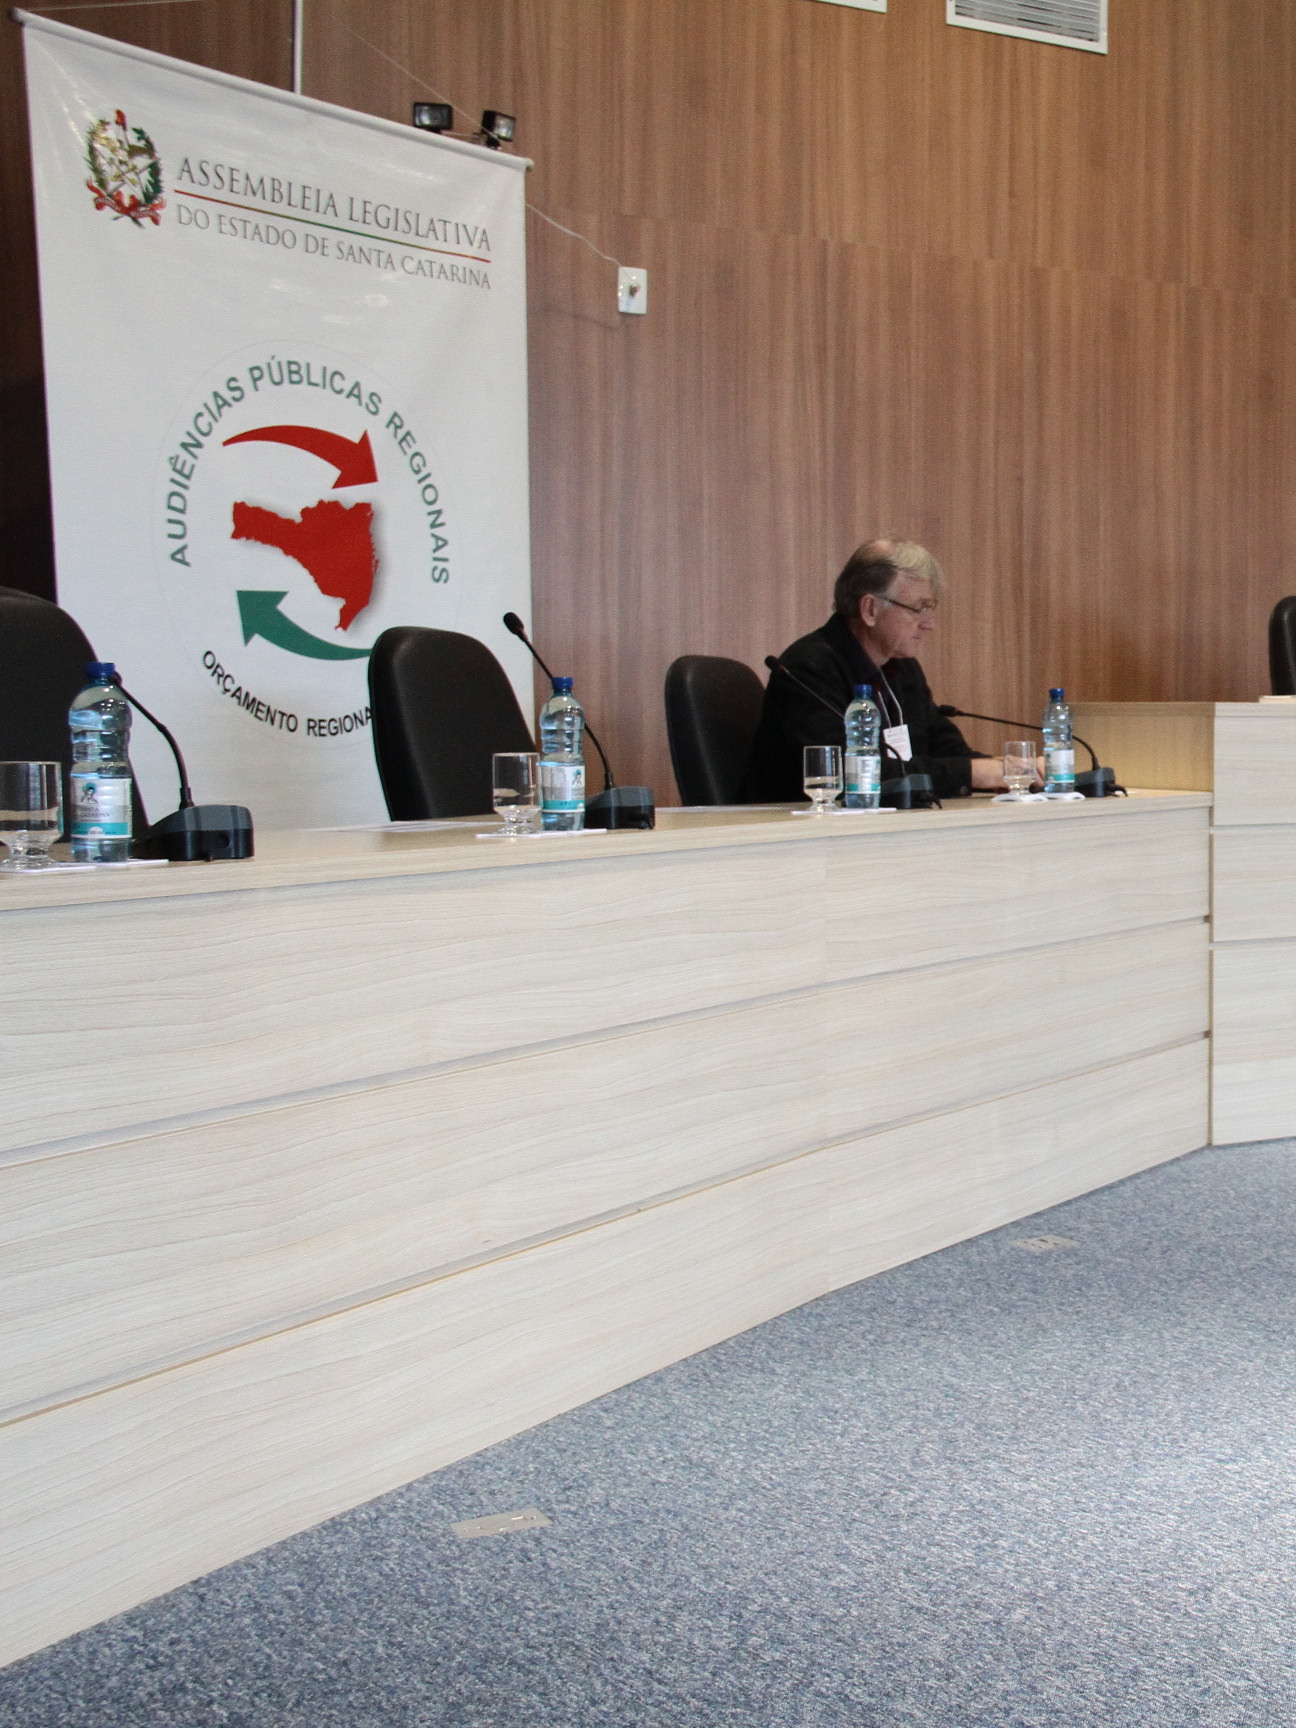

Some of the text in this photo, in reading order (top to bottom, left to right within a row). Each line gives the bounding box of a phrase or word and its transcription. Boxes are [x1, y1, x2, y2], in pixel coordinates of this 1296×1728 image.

[177, 157, 491, 251] ASSEMBLEIA LEGISLATIVA
[177, 204, 491, 290] DO ESTADO DE SANTA CATARINA
[167, 355, 450, 584] AUDIÊNCIAS PÚBLICAS REGIONAIS
[202, 650, 299, 733] ORÇAMENTO
